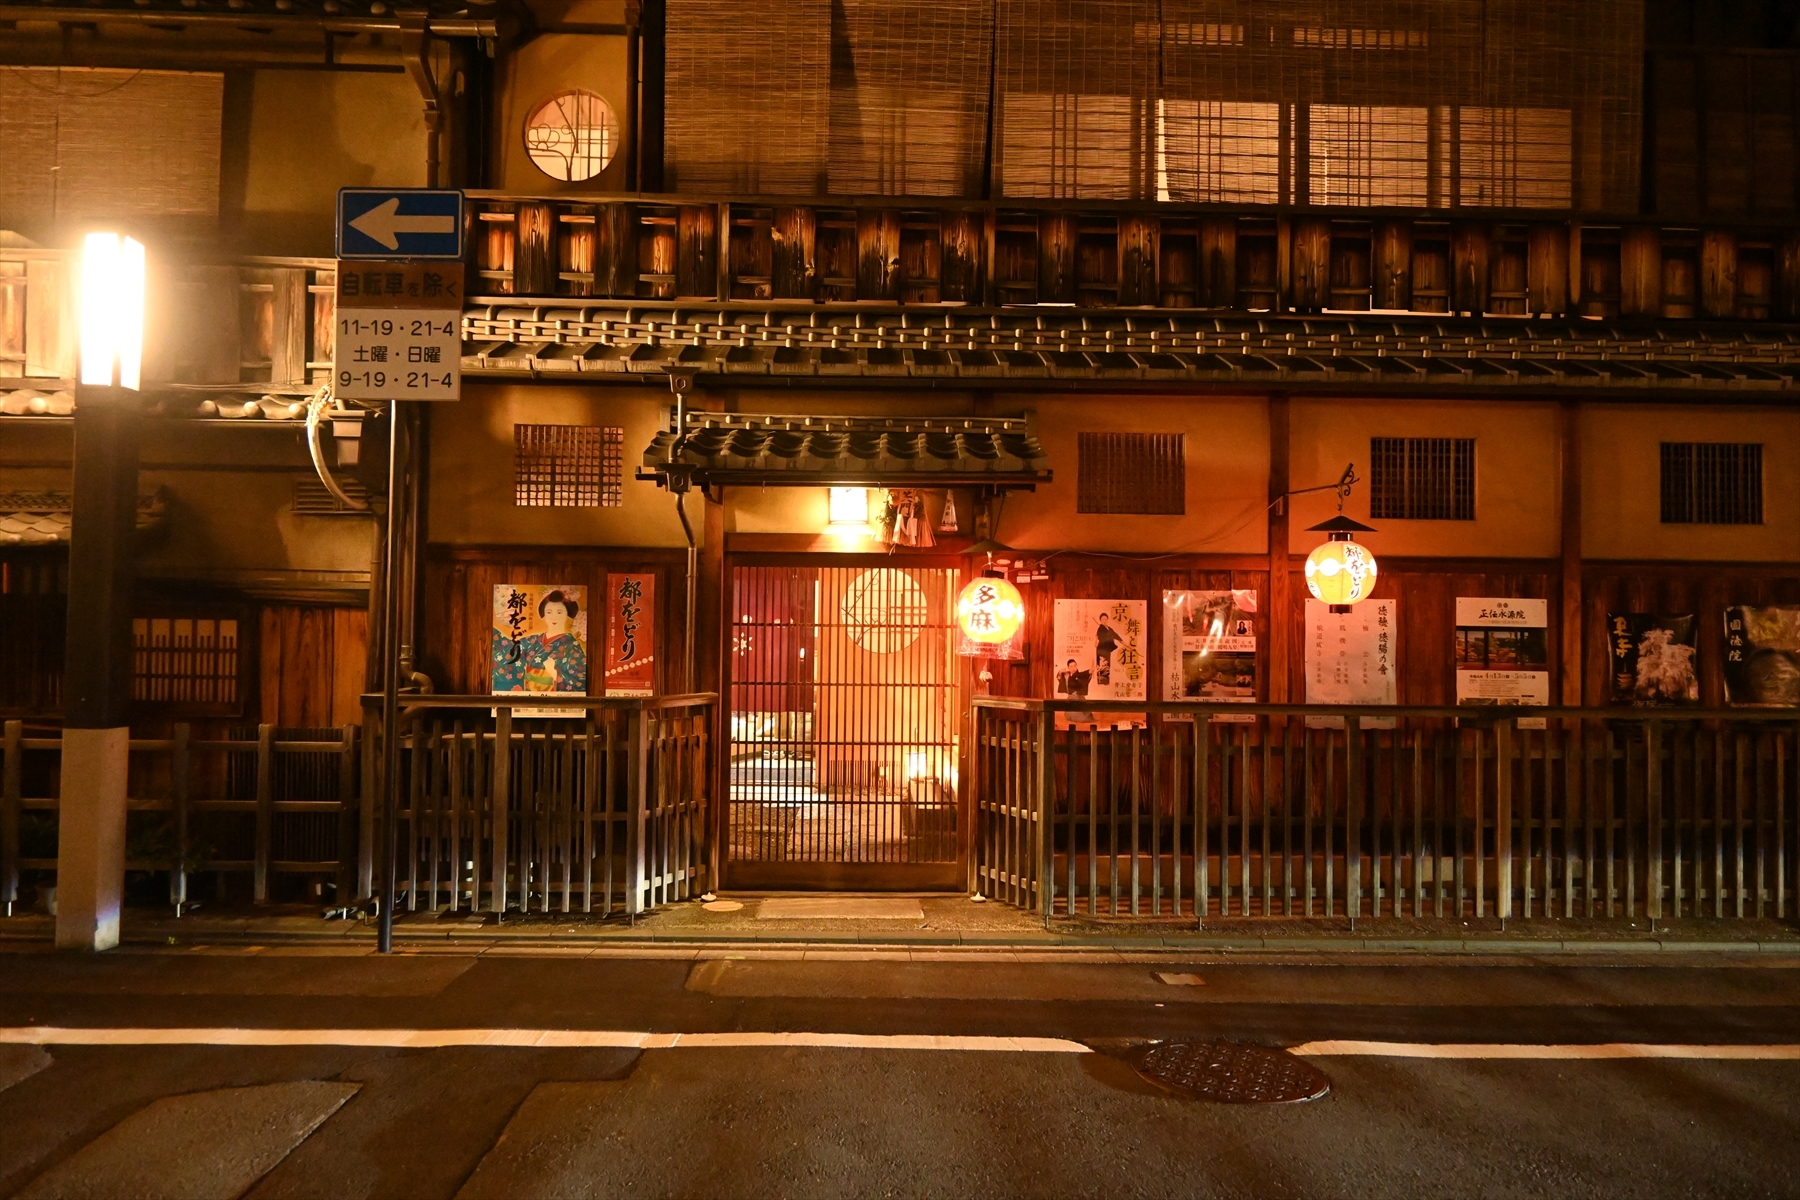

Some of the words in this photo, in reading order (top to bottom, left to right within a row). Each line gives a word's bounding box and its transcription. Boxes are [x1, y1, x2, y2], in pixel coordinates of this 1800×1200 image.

[341, 272, 457, 298] 自転車を除く
[353, 345, 441, 363] 土曜・日曜
[507, 589, 528, 665] 都をどり
[618, 576, 642, 662] 都をどり
[971, 585, 996, 630] 多麻
[1112, 603, 1141, 681] 京舞と狂言
